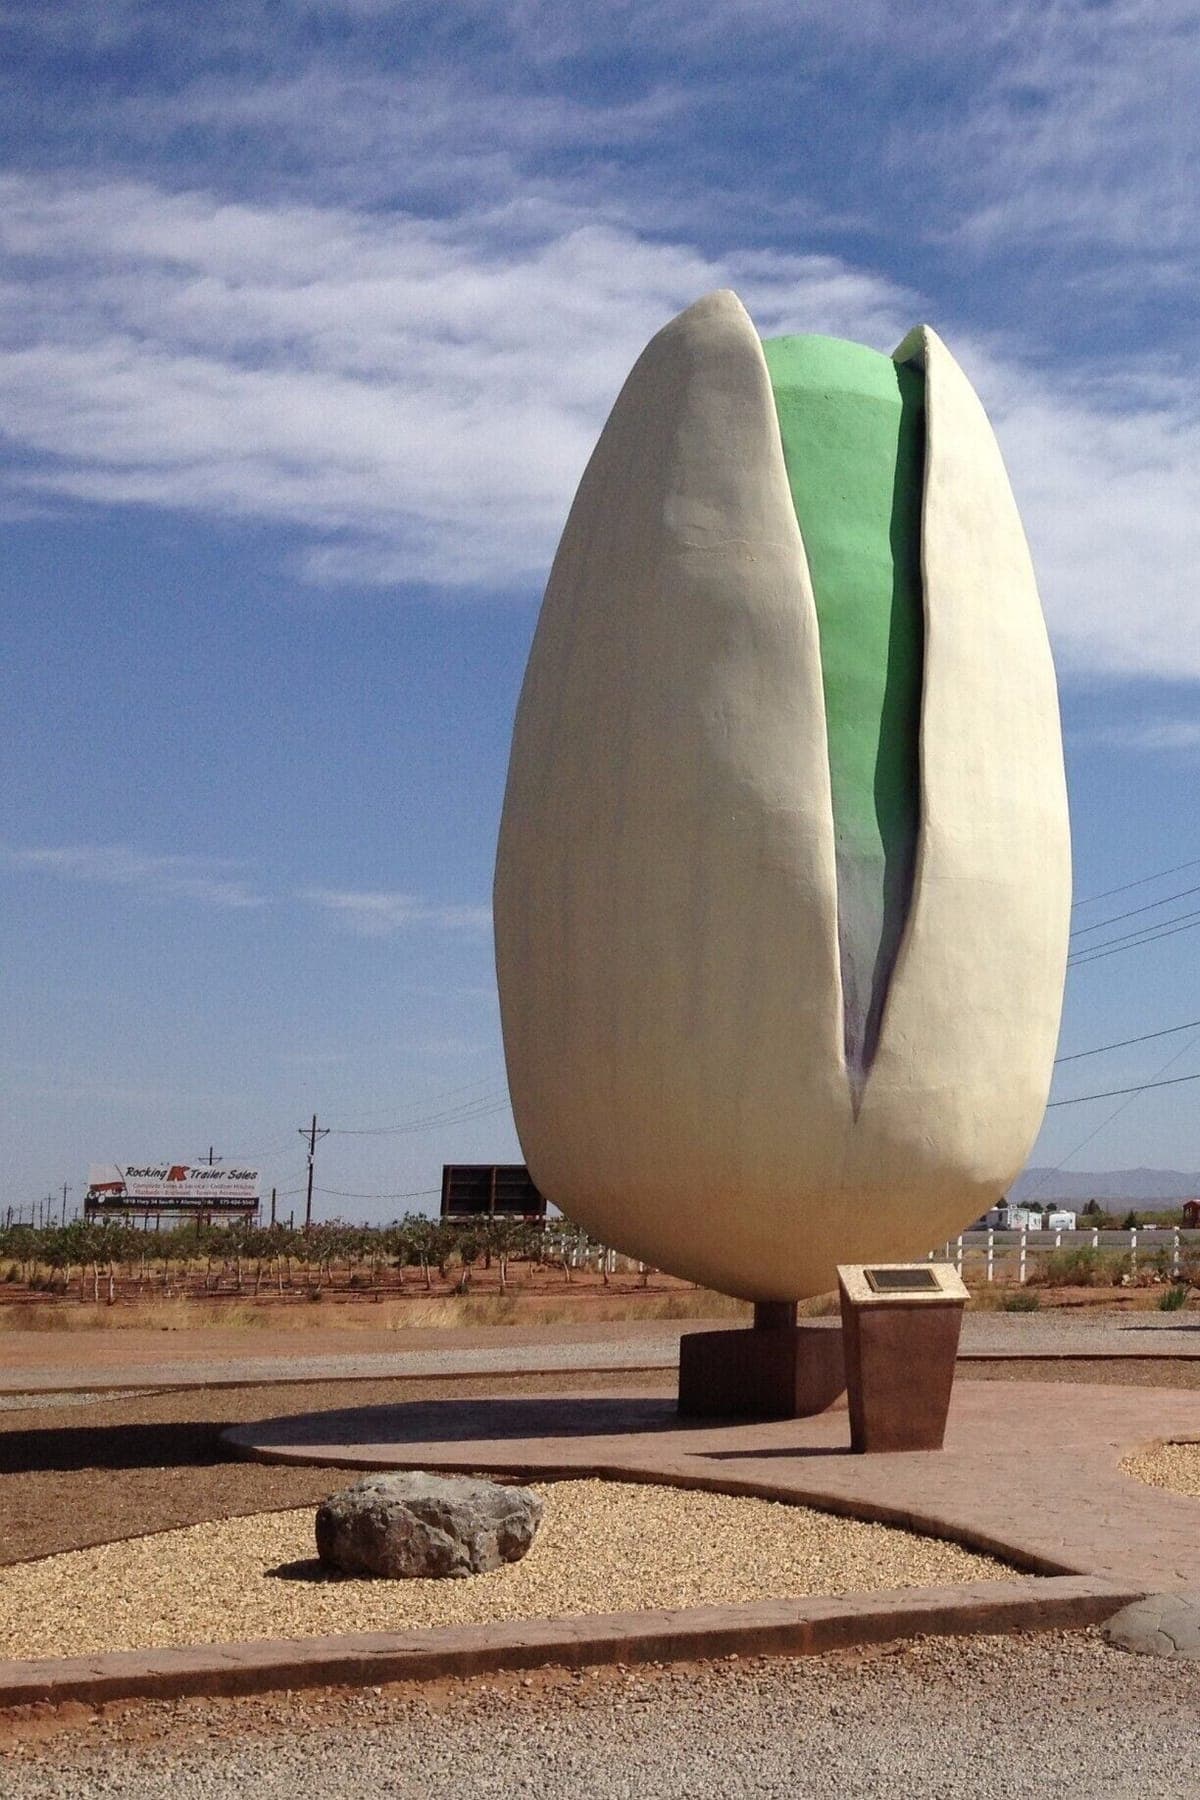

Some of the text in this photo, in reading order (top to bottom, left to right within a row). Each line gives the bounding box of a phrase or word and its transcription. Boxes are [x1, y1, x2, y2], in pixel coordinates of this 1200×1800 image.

[125, 1166, 168, 1181] Rocking
[190, 1169, 226, 1179] Trailer
[227, 1169, 258, 1180] Sales
